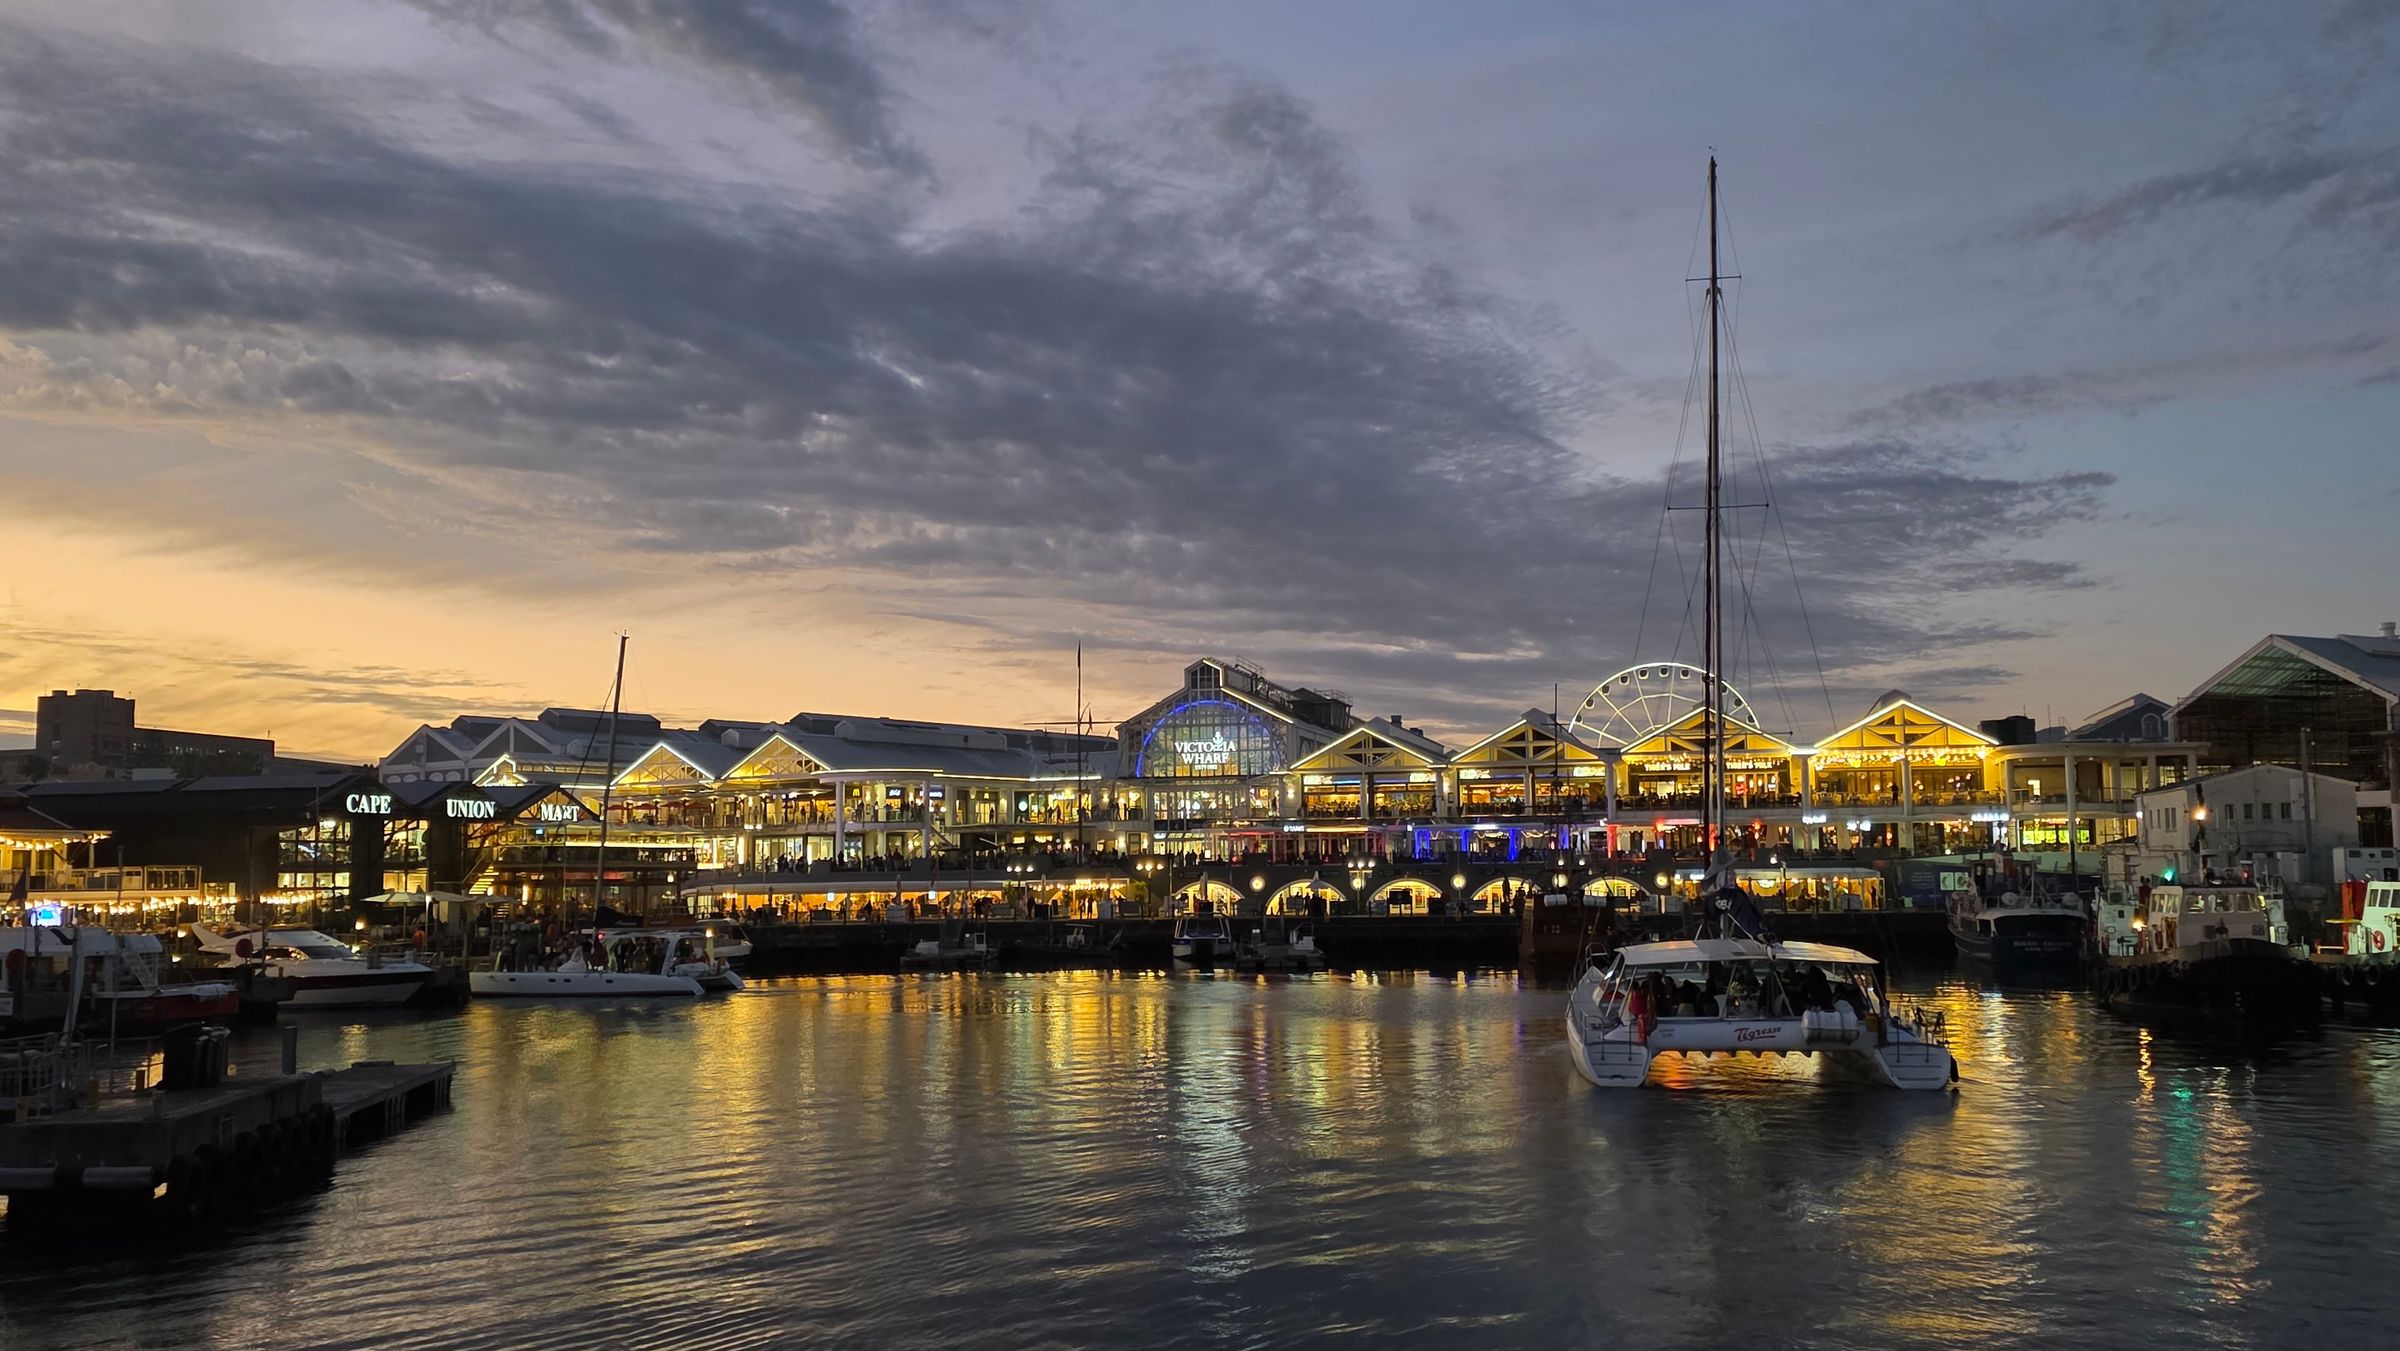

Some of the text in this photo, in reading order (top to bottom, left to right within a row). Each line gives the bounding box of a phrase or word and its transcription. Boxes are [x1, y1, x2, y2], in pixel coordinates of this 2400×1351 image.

[1174, 740, 1236, 753] VICTORIA
[1181, 752, 1229, 765] WHARF
[346, 793, 580, 822] CAPE UNION MART
[1734, 1026, 1782, 1042] Tigresse
